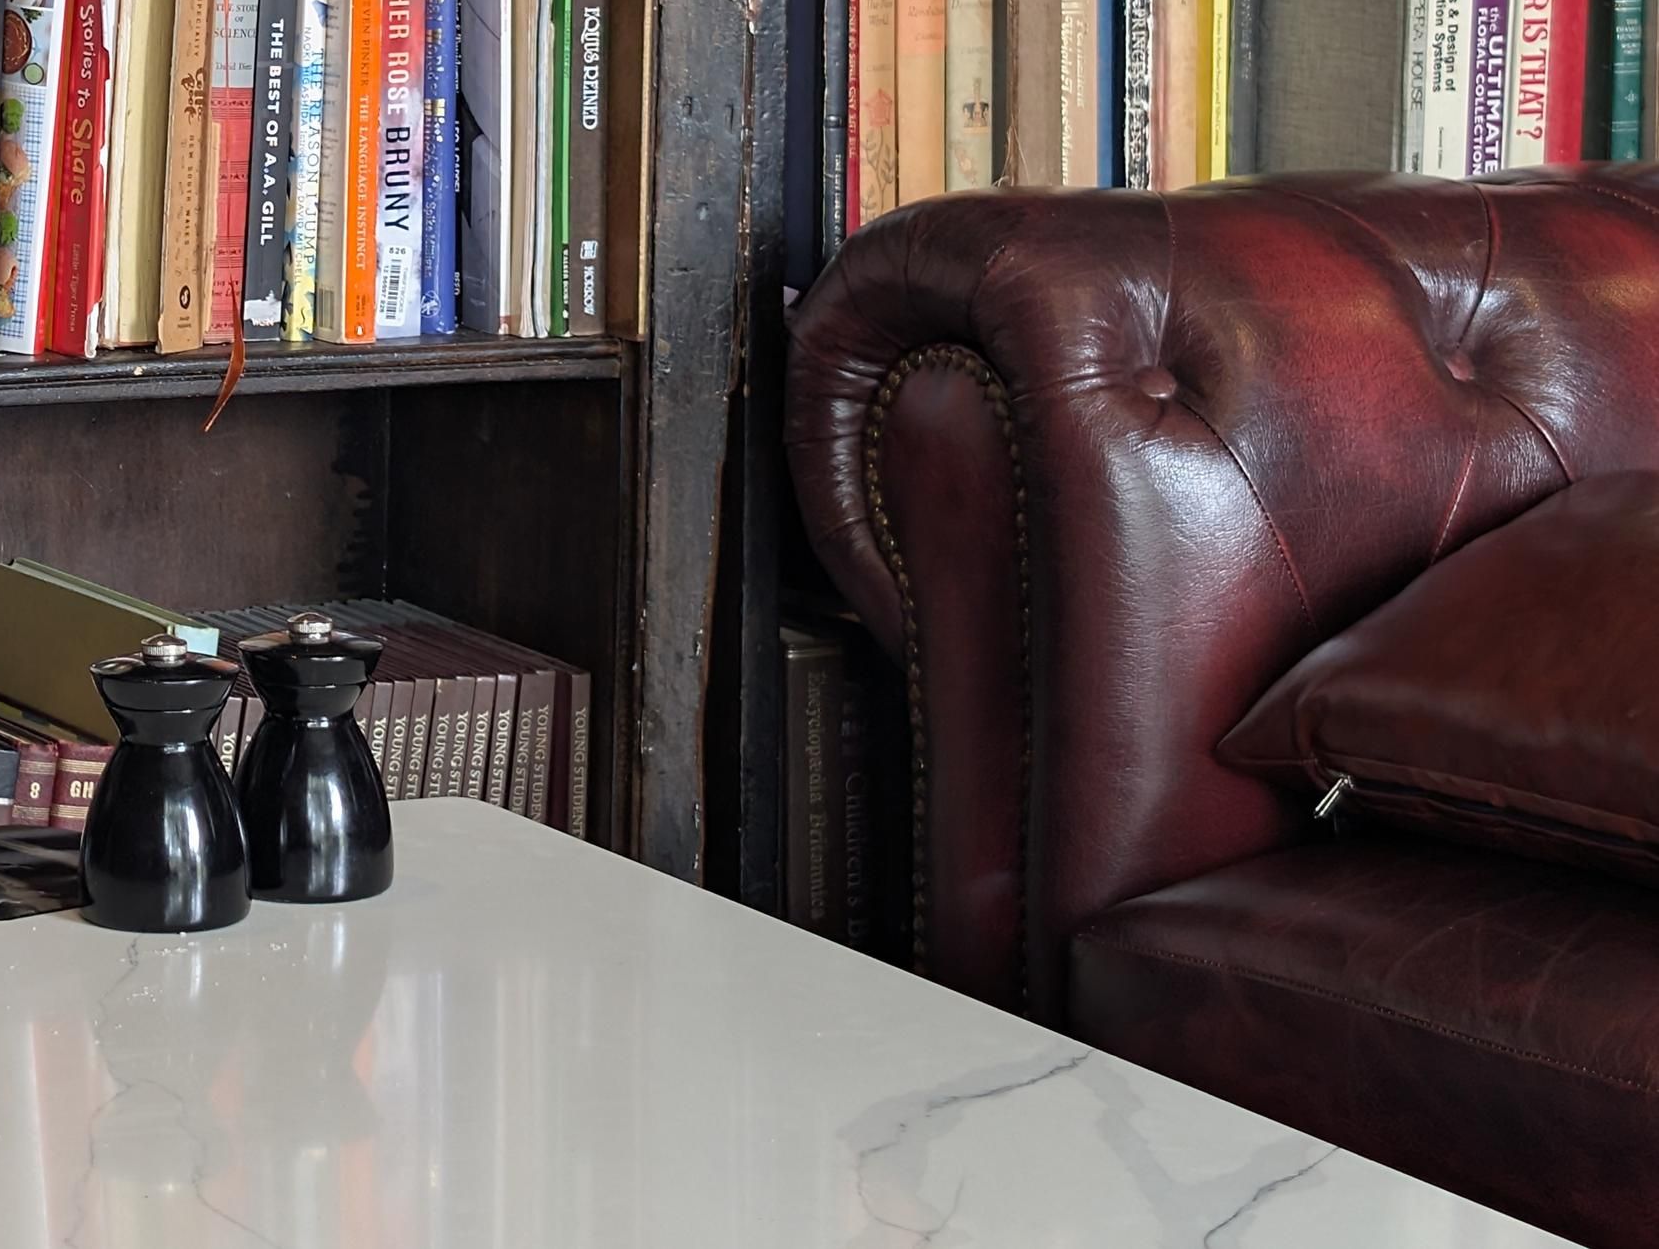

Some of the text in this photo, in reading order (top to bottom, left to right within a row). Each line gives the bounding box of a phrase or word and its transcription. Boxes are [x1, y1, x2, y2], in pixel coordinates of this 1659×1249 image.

[1449, 9, 1459, 18] &
[1522, 18, 1548, 43] IS
[271, 19, 284, 59] THE
[360, 39, 370, 87] PINKER
[1432, 33, 1445, 92] Systems
[1444, 25, 1458, 73] Design
[71, 4, 95, 205] Stories to Share
[268, 66, 282, 114] BEST
[388, 52, 410, 115] ROSE
[582, 66, 600, 130] REINED
[1445, 78, 1456, 91] of
[1472, 7, 1488, 174] FLORAL COLLECTION
[1484, 7, 1503, 173] the ULTIMATE
[266, 120, 279, 147] OF
[355, 97, 369, 270] THE LANGUAGE INSTINCT
[384, 126, 411, 232] BRUNY
[260, 201, 275, 245] GILL
[30, 782, 40, 798] 8
